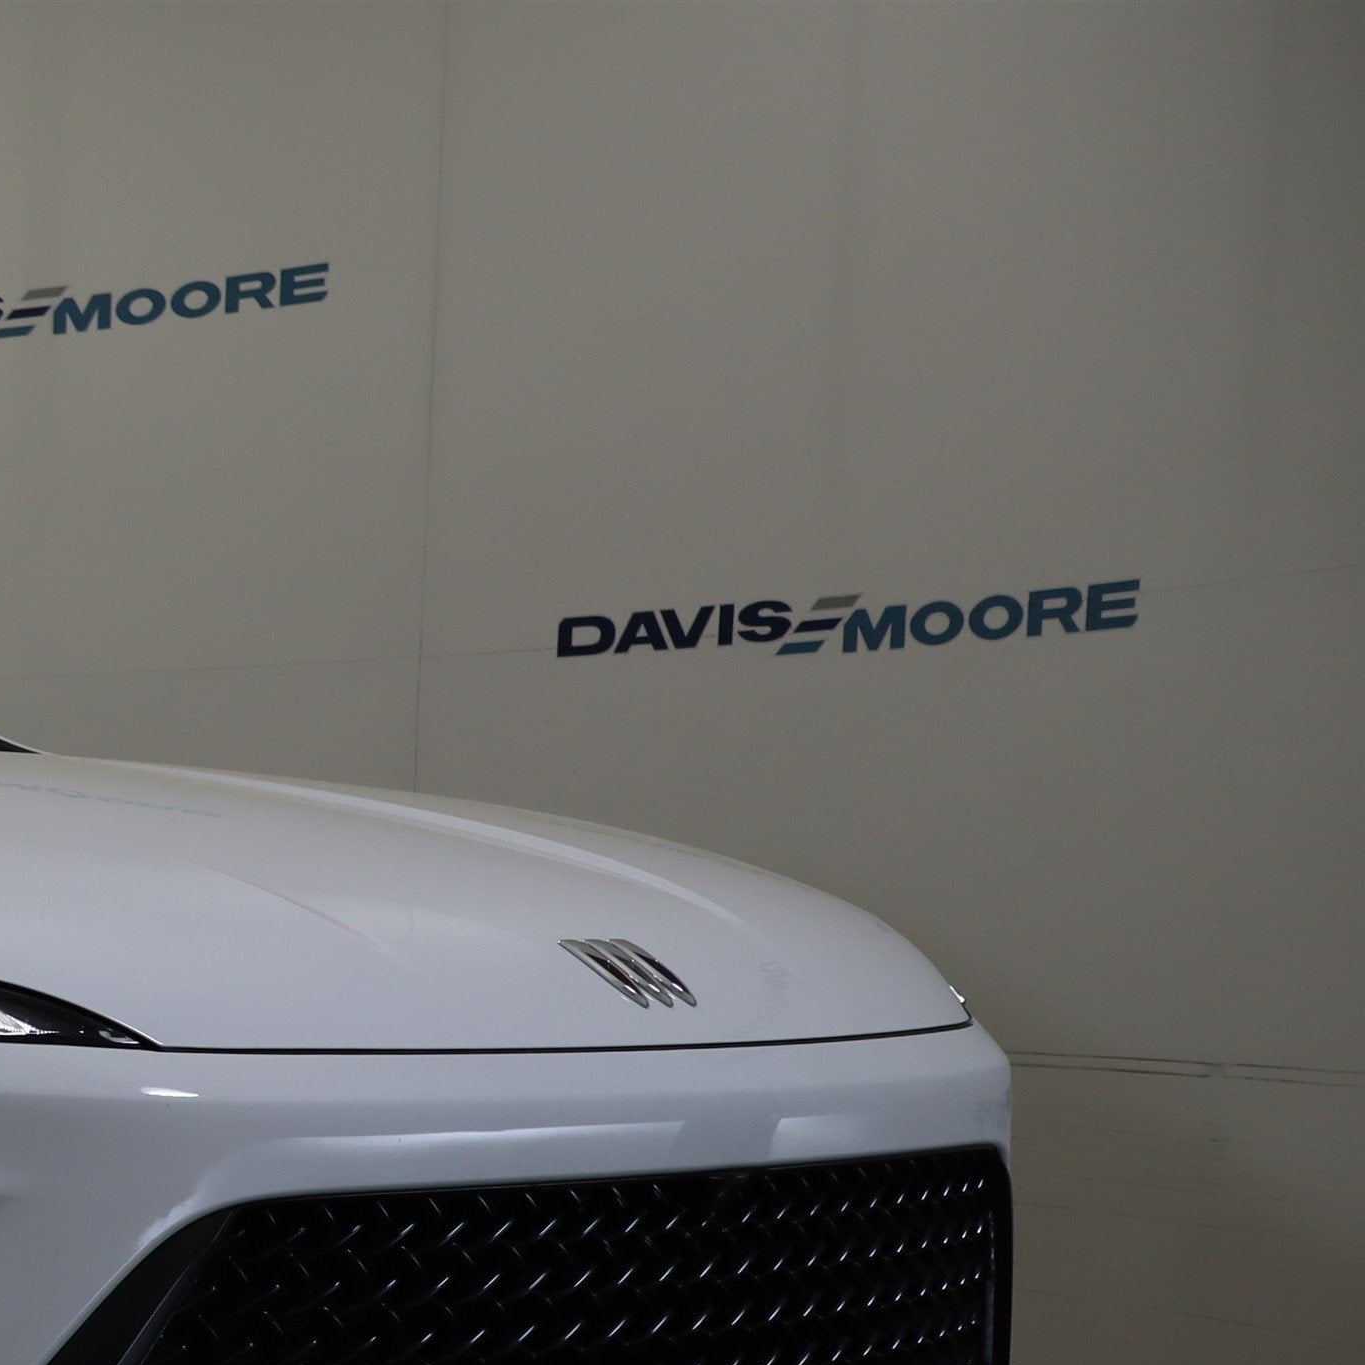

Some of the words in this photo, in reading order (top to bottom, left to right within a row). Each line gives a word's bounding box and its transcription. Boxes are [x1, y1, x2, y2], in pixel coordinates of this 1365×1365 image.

[52, 262, 329, 335] MOORE
[556, 600, 793, 657] DAVIS
[842, 579, 1141, 654] MOORE
